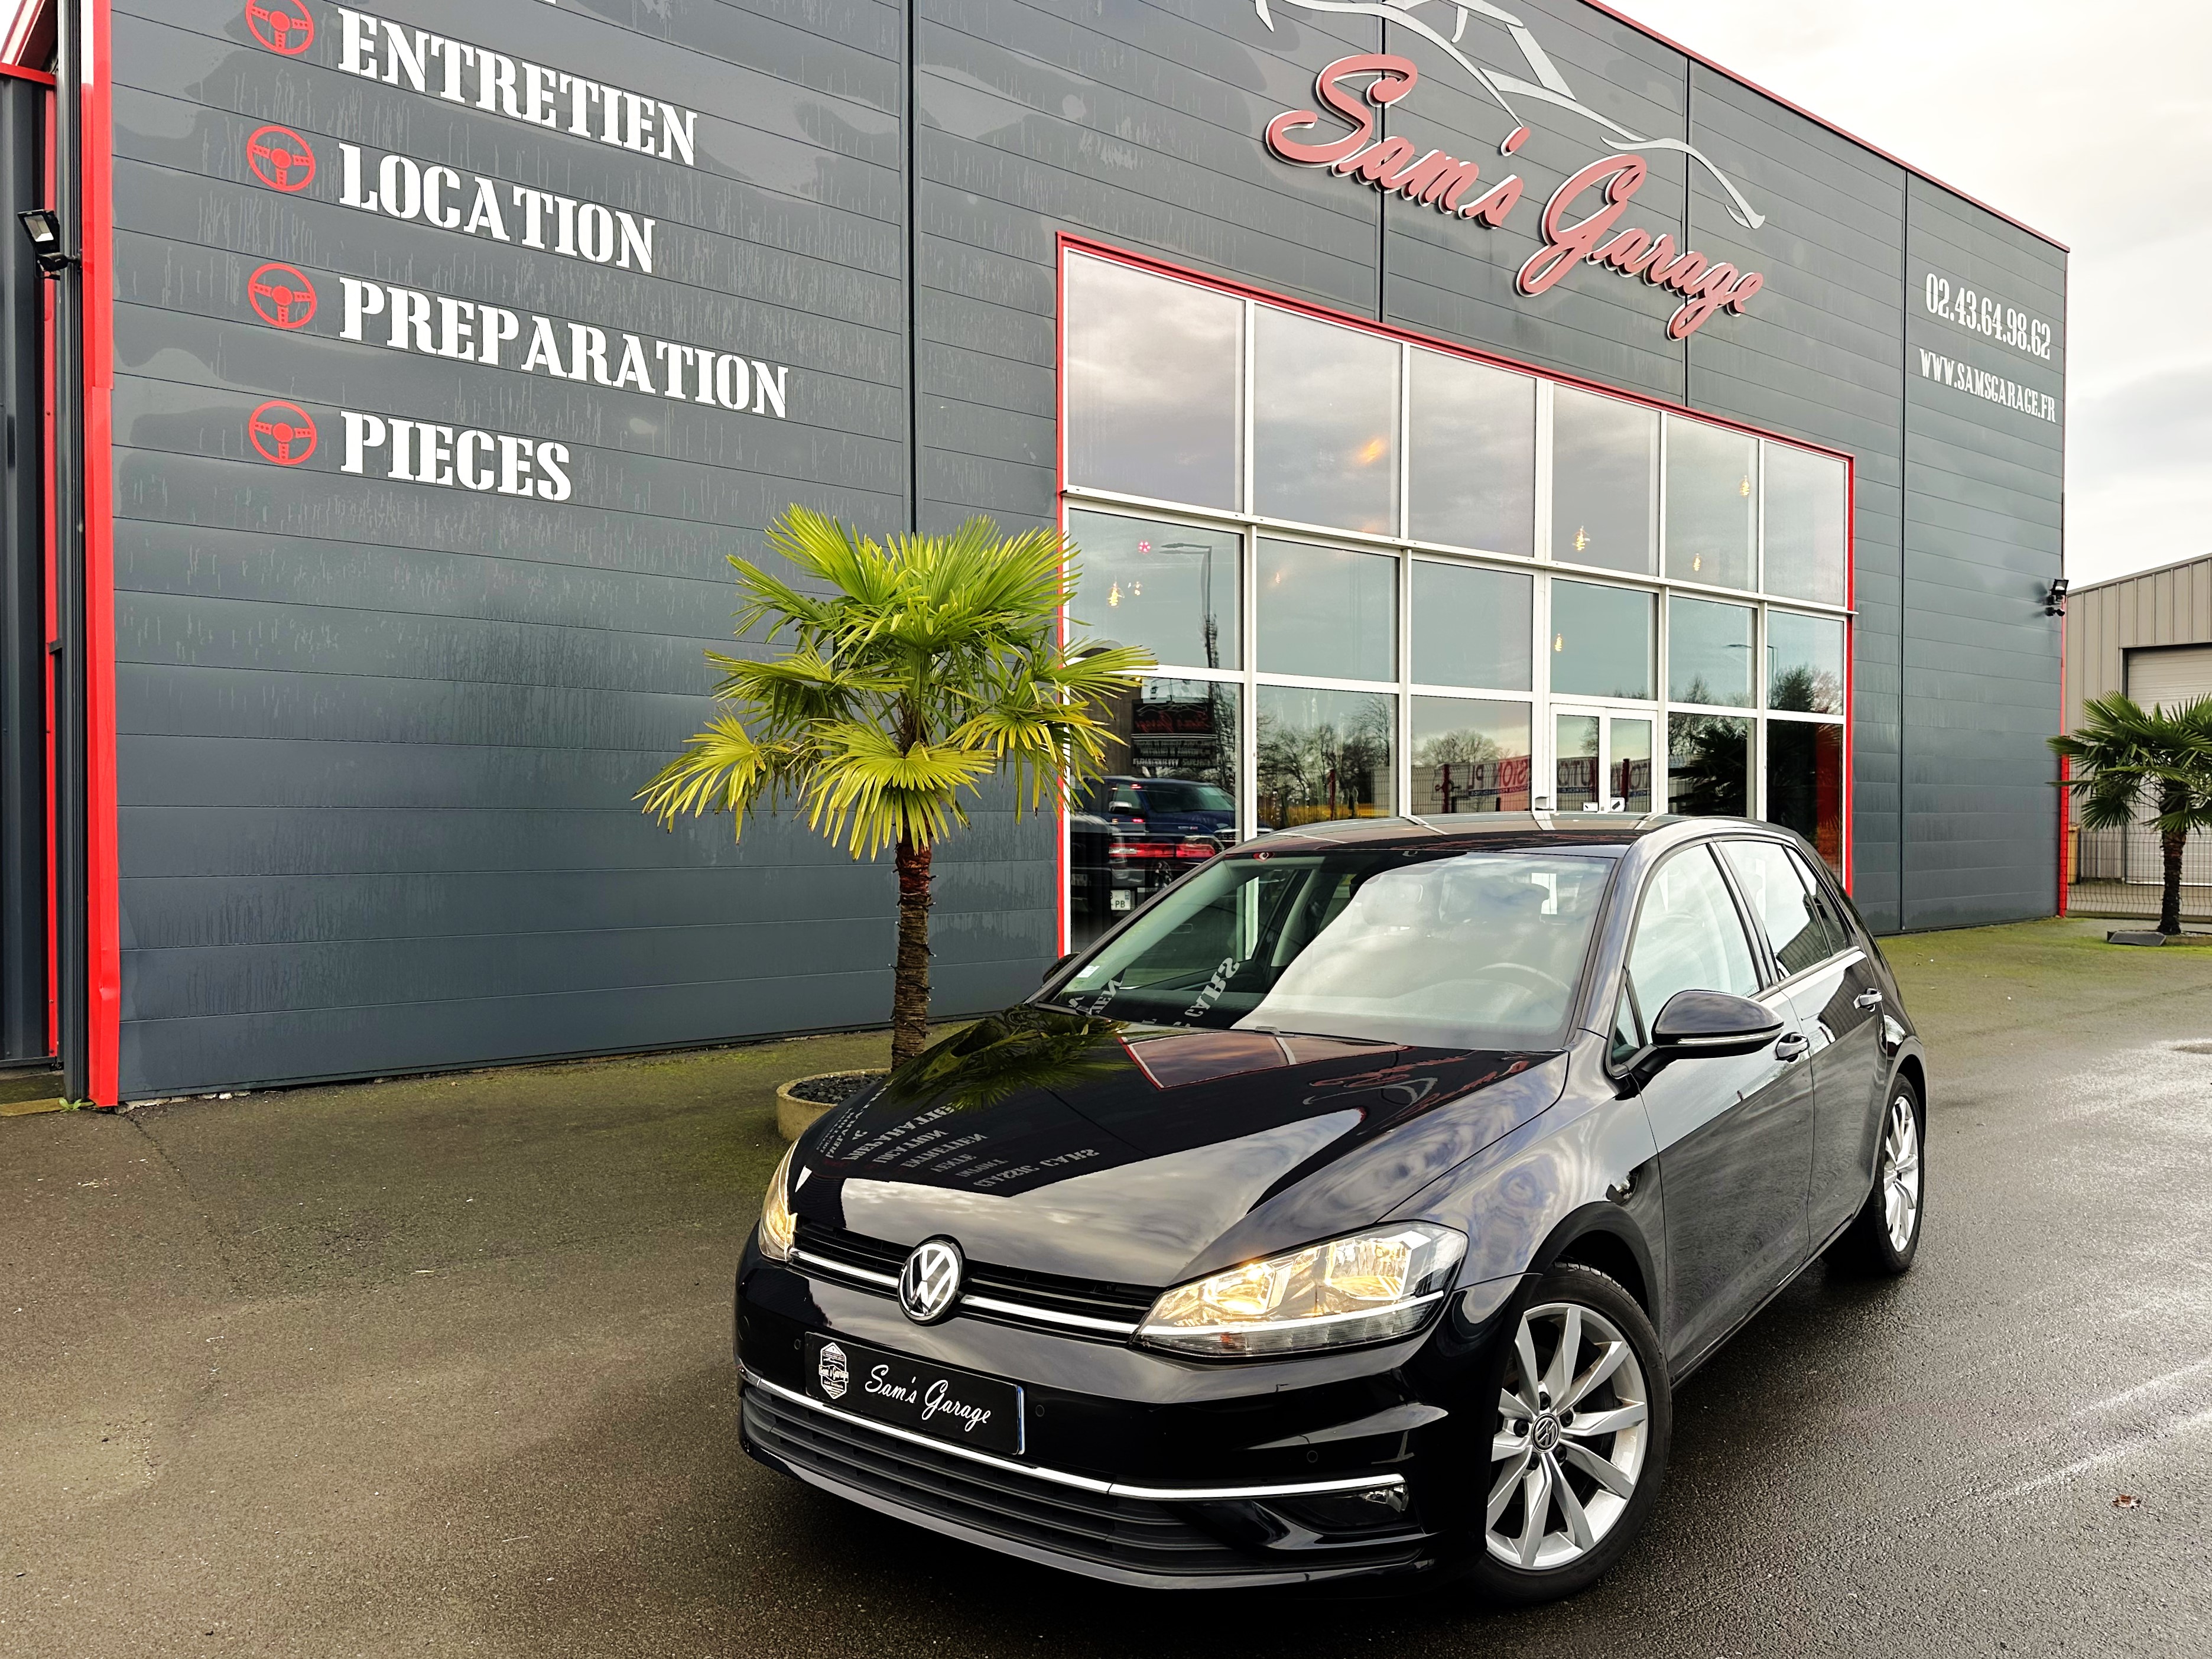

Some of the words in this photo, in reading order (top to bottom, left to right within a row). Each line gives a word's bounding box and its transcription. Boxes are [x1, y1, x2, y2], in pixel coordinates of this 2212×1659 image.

[337, 7, 697, 167] ENTRETIEN
[339, 142, 655, 274] LOCATION
[1265, 54, 1530, 229] Sam's
[1516, 154, 1763, 342] Garage
[339, 277, 788, 418] PREPARATION
[1925, 273, 2051, 361] 02.43.64.98.62
[1919, 348, 2056, 423] WWW.SAMSGARAGE.FR
[340, 410, 572, 501] PIECES
[865, 1364, 917, 1404] Sam's
[922, 1379, 991, 1431] Garage
